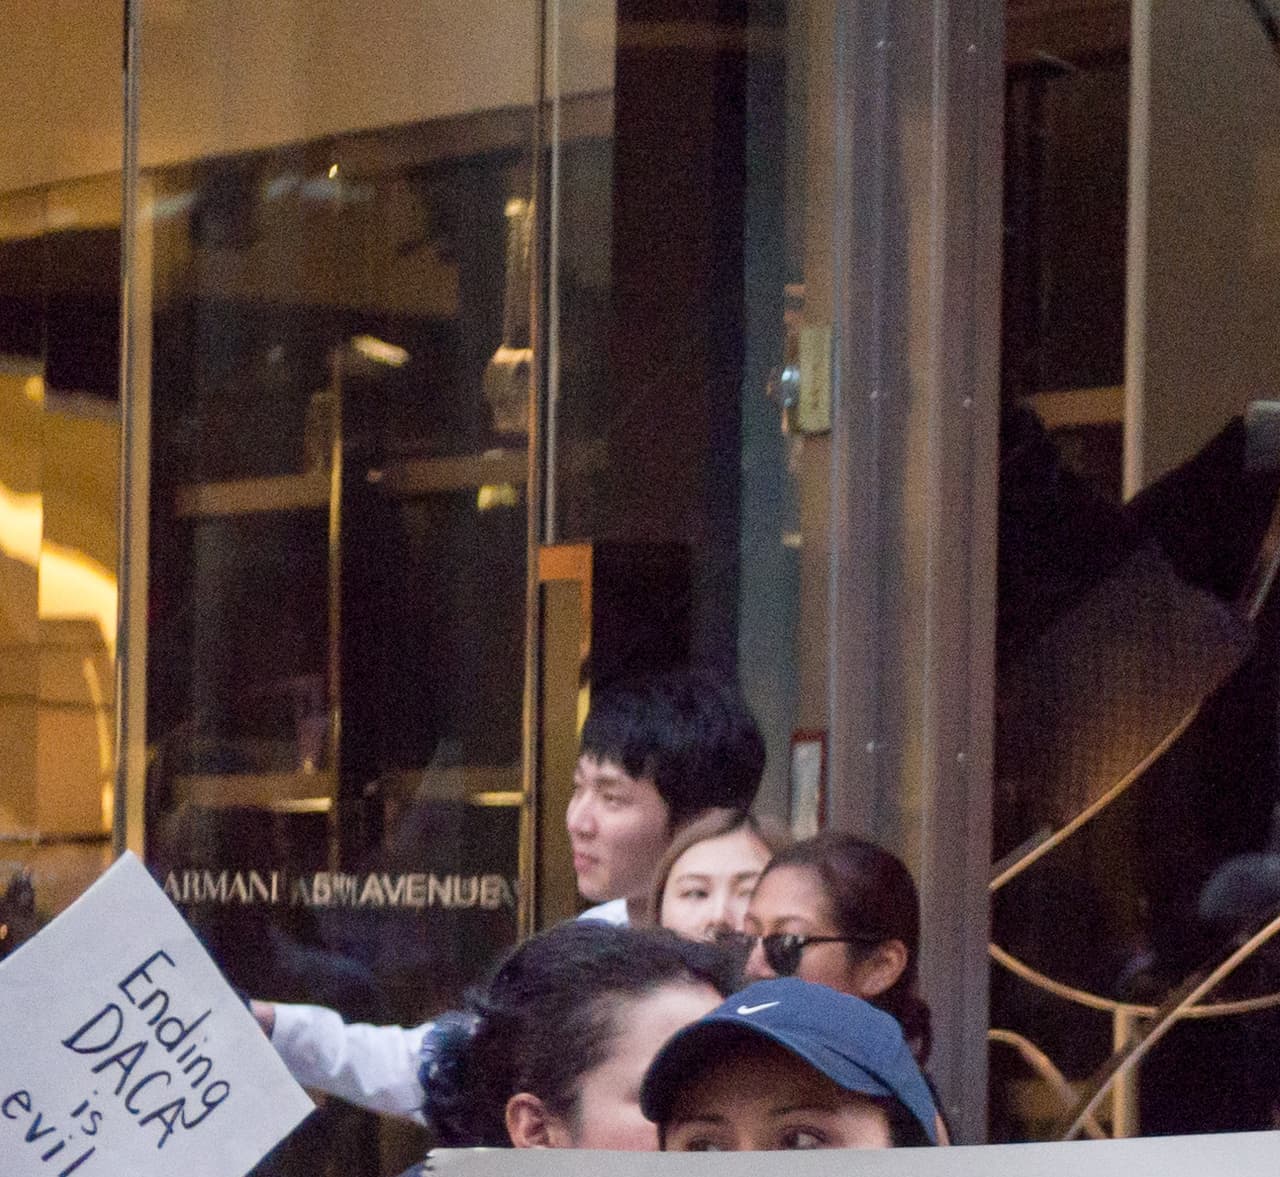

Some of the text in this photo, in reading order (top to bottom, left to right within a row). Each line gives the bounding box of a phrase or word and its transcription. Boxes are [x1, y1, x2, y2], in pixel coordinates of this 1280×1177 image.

[164, 869, 280, 904] ARMANI
[360, 872, 502, 909] AVENUE
[61, 1003, 186, 1149] DACA
[118, 950, 231, 1129] Ending
[71, 1089, 103, 1136] is
